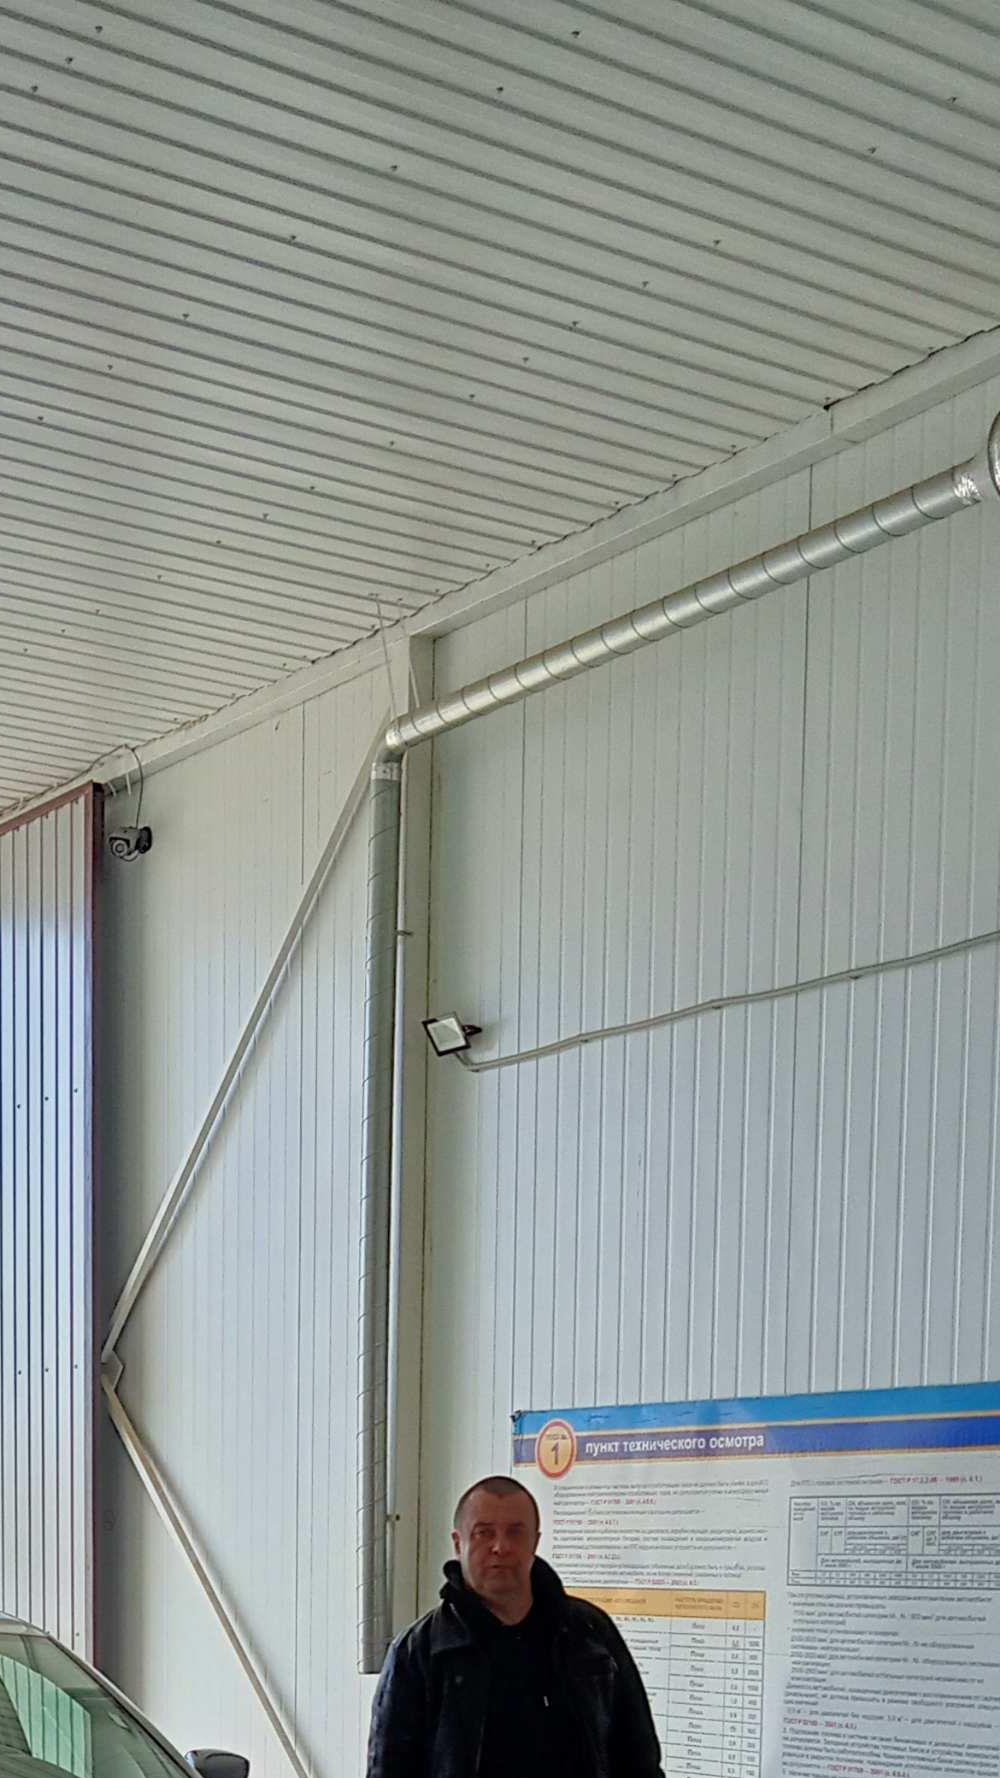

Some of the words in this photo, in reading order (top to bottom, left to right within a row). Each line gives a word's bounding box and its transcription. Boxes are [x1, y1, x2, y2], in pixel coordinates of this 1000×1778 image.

[551, 1442, 559, 1465] 1
[585, 1443, 619, 1456] пункт
[623, 1436, 705, 1453] технического
[709, 1434, 764, 1449] осмотра
